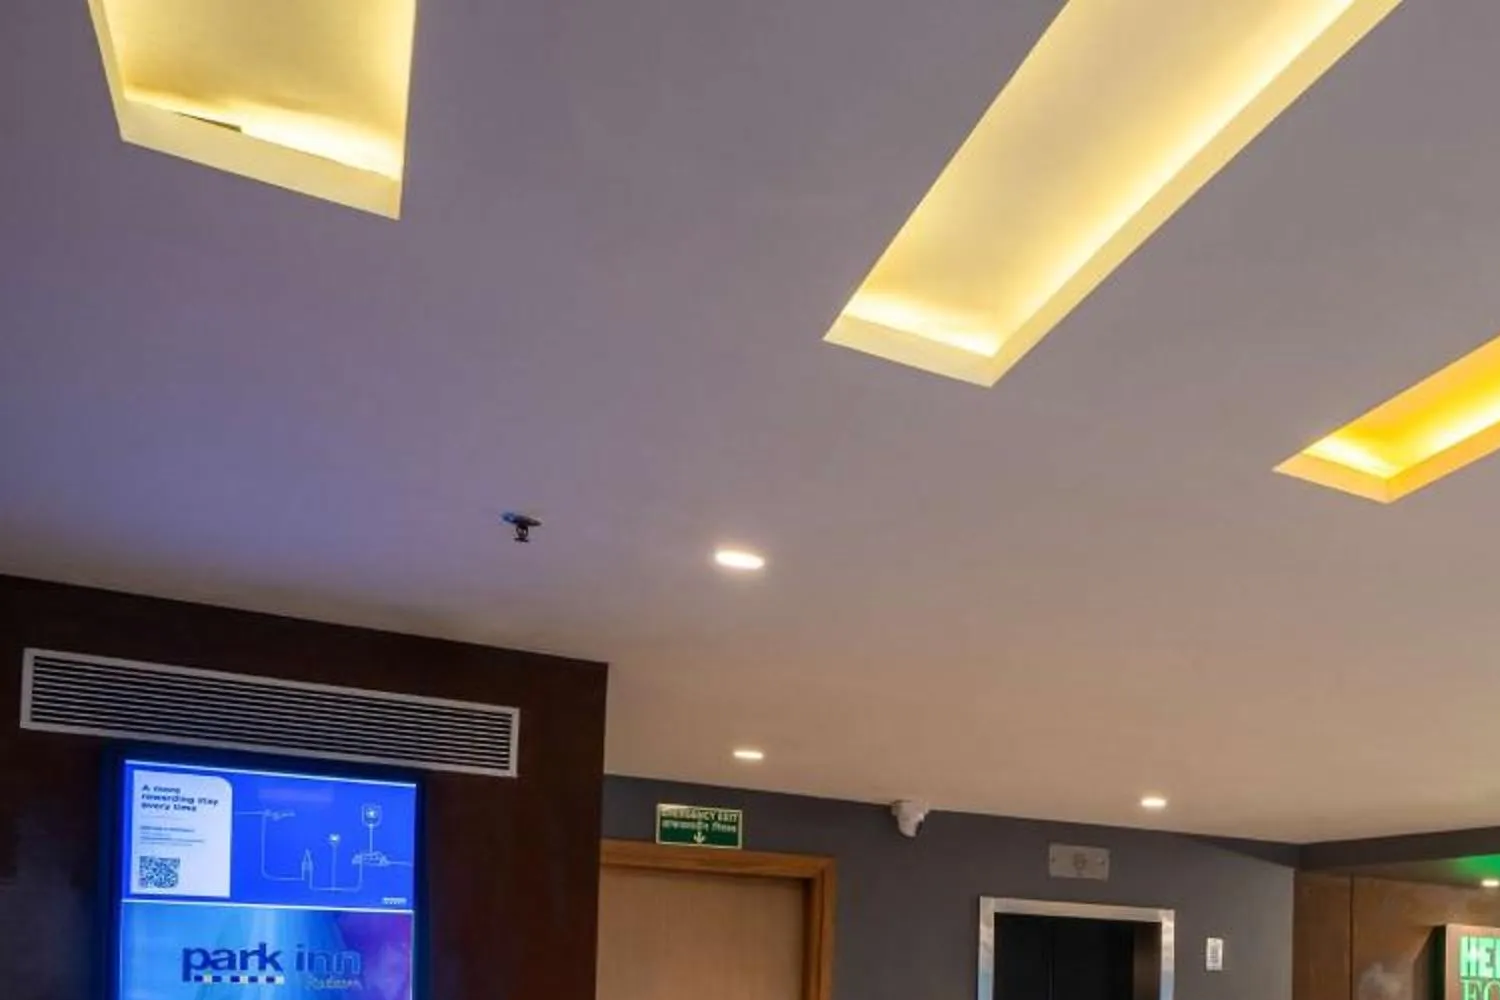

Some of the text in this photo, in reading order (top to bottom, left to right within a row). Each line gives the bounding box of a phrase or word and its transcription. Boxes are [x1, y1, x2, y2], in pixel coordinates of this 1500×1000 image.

[142, 784, 150, 792] A
[182, 942, 362, 983] park inn
